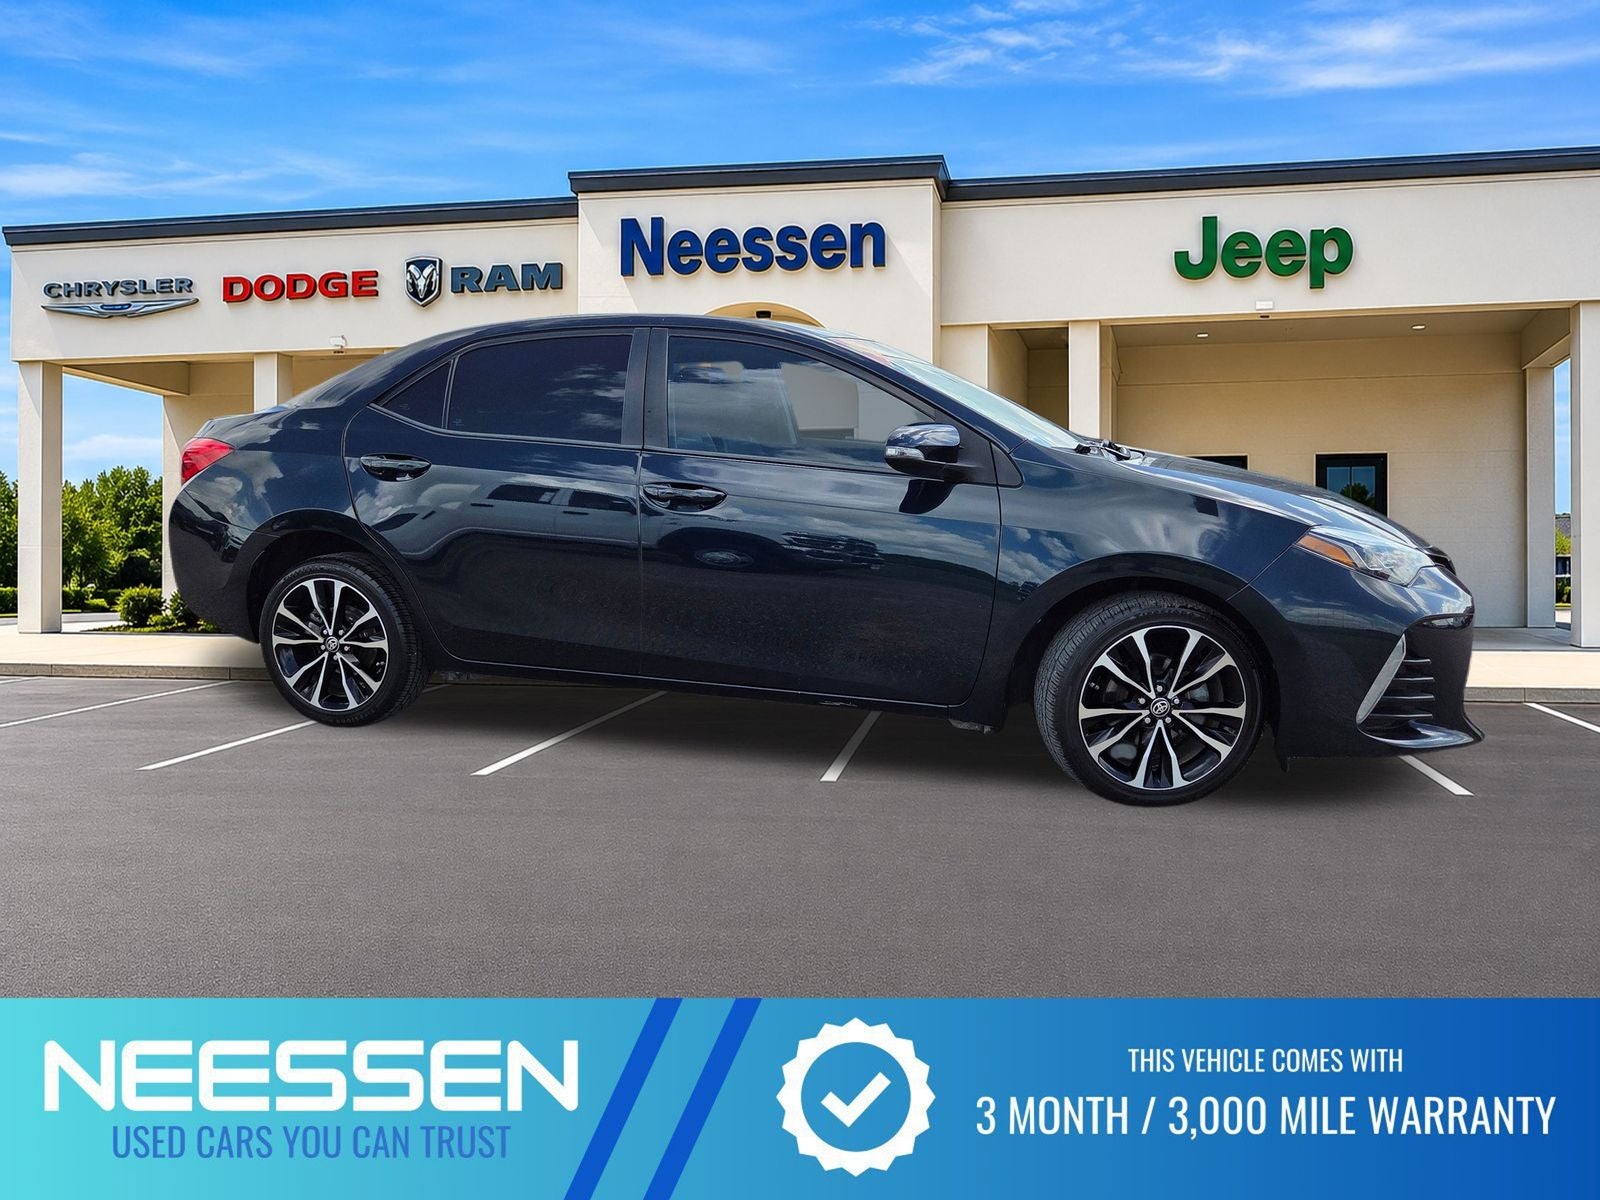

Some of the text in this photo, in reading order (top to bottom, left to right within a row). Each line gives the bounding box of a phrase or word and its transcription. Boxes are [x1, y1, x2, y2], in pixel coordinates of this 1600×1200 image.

[620, 216, 886, 277] Neessen
[1174, 215, 1354, 289] Jeep
[43, 277, 194, 299] CHRYSLER
[222, 270, 379, 303] DODGE
[450, 262, 564, 294] RAM
